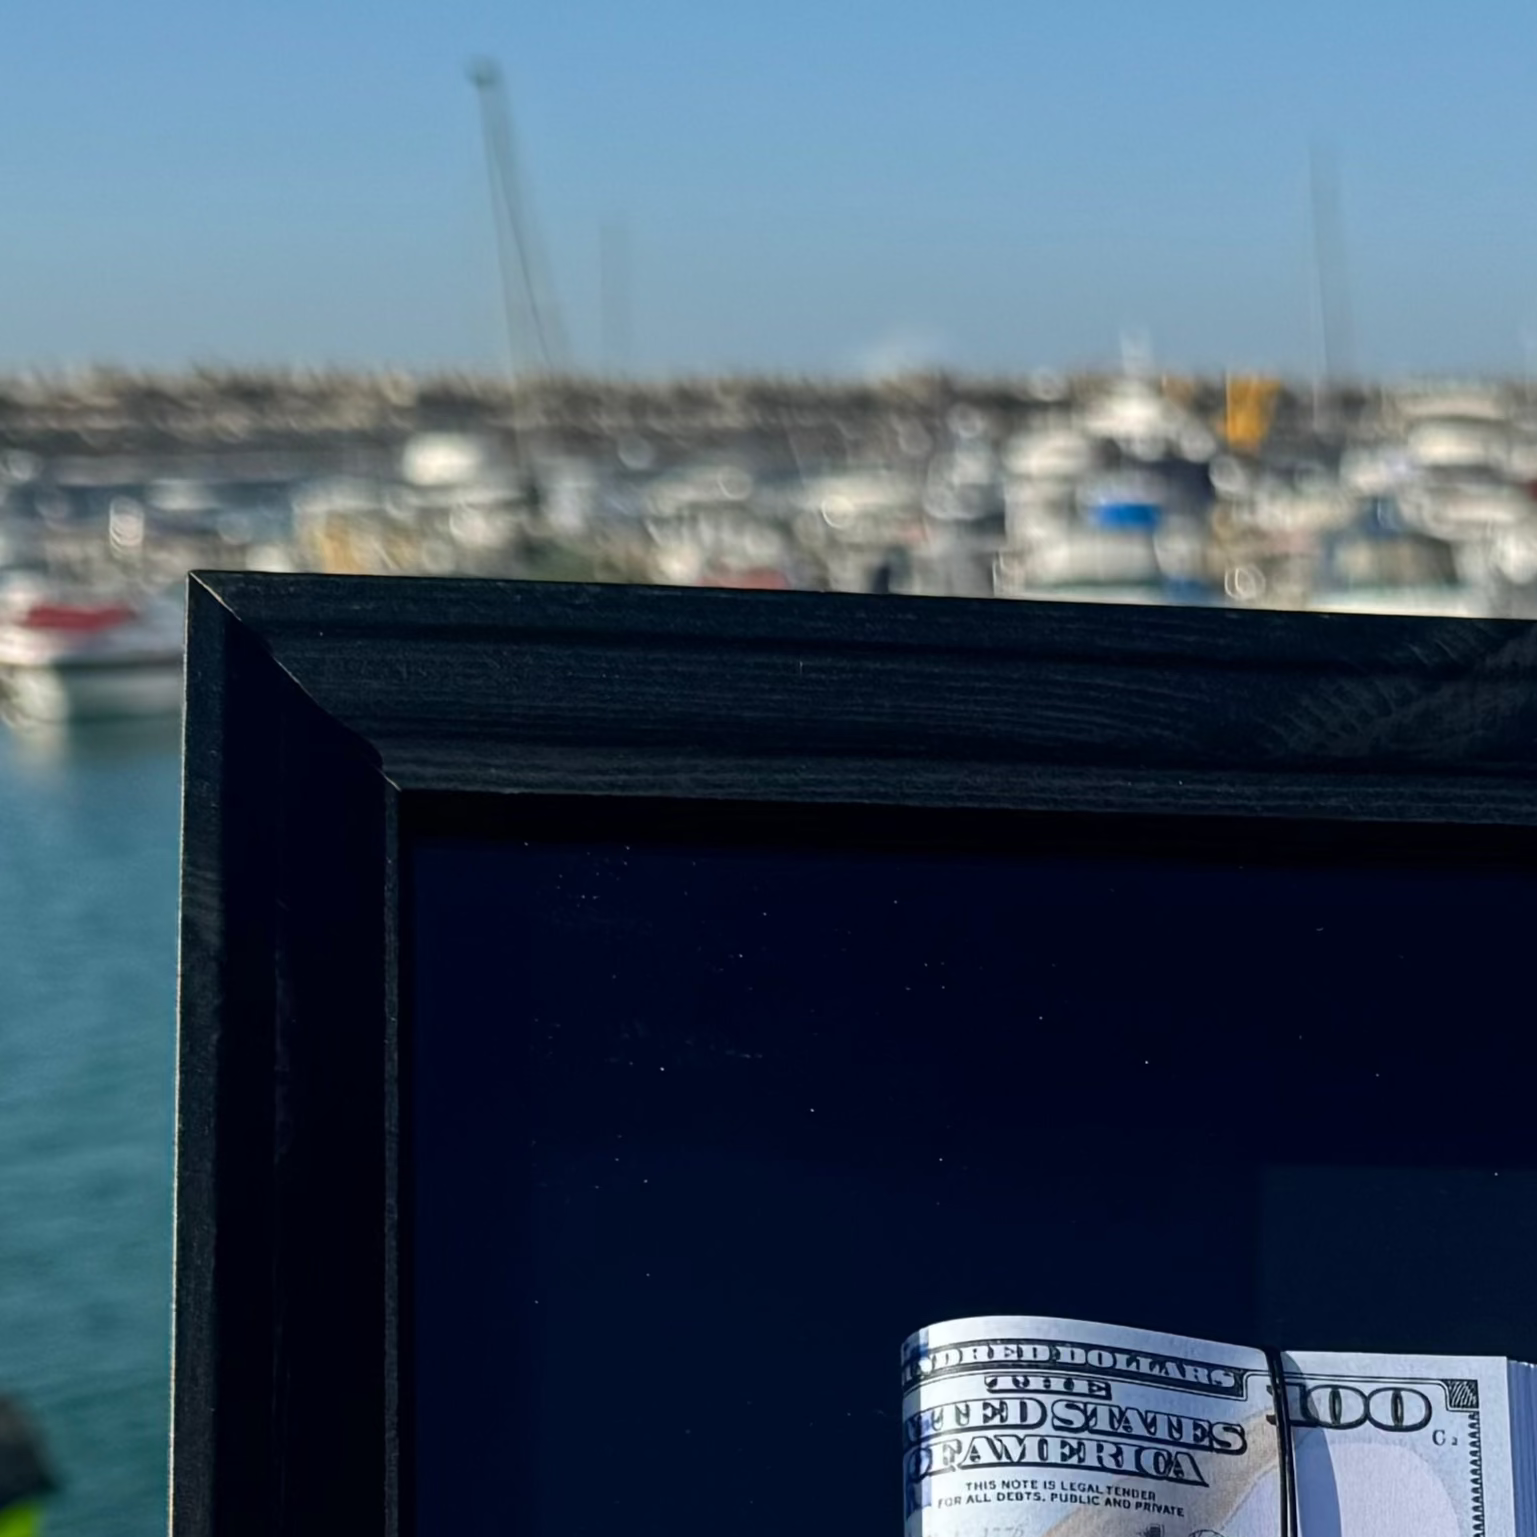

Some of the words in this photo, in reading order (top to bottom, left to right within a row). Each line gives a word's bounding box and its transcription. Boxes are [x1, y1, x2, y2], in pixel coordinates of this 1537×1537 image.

[1052, 1345, 1237, 1389] DOLLARS
[1051, 1398, 1248, 1456] STATES
[957, 1434, 1210, 1488] AMERICA
[965, 1480, 997, 1492] THIS
[1001, 1479, 1039, 1490] NOTE
[1043, 1480, 1054, 1490] IS
[1060, 1481, 1103, 1495] LEGAL
[1105, 1485, 1157, 1502] TENDER
[965, 1492, 991, 1504] ALL
[1104, 1497, 1132, 1510] AND
[1134, 1501, 1185, 1518] PRIVATE
